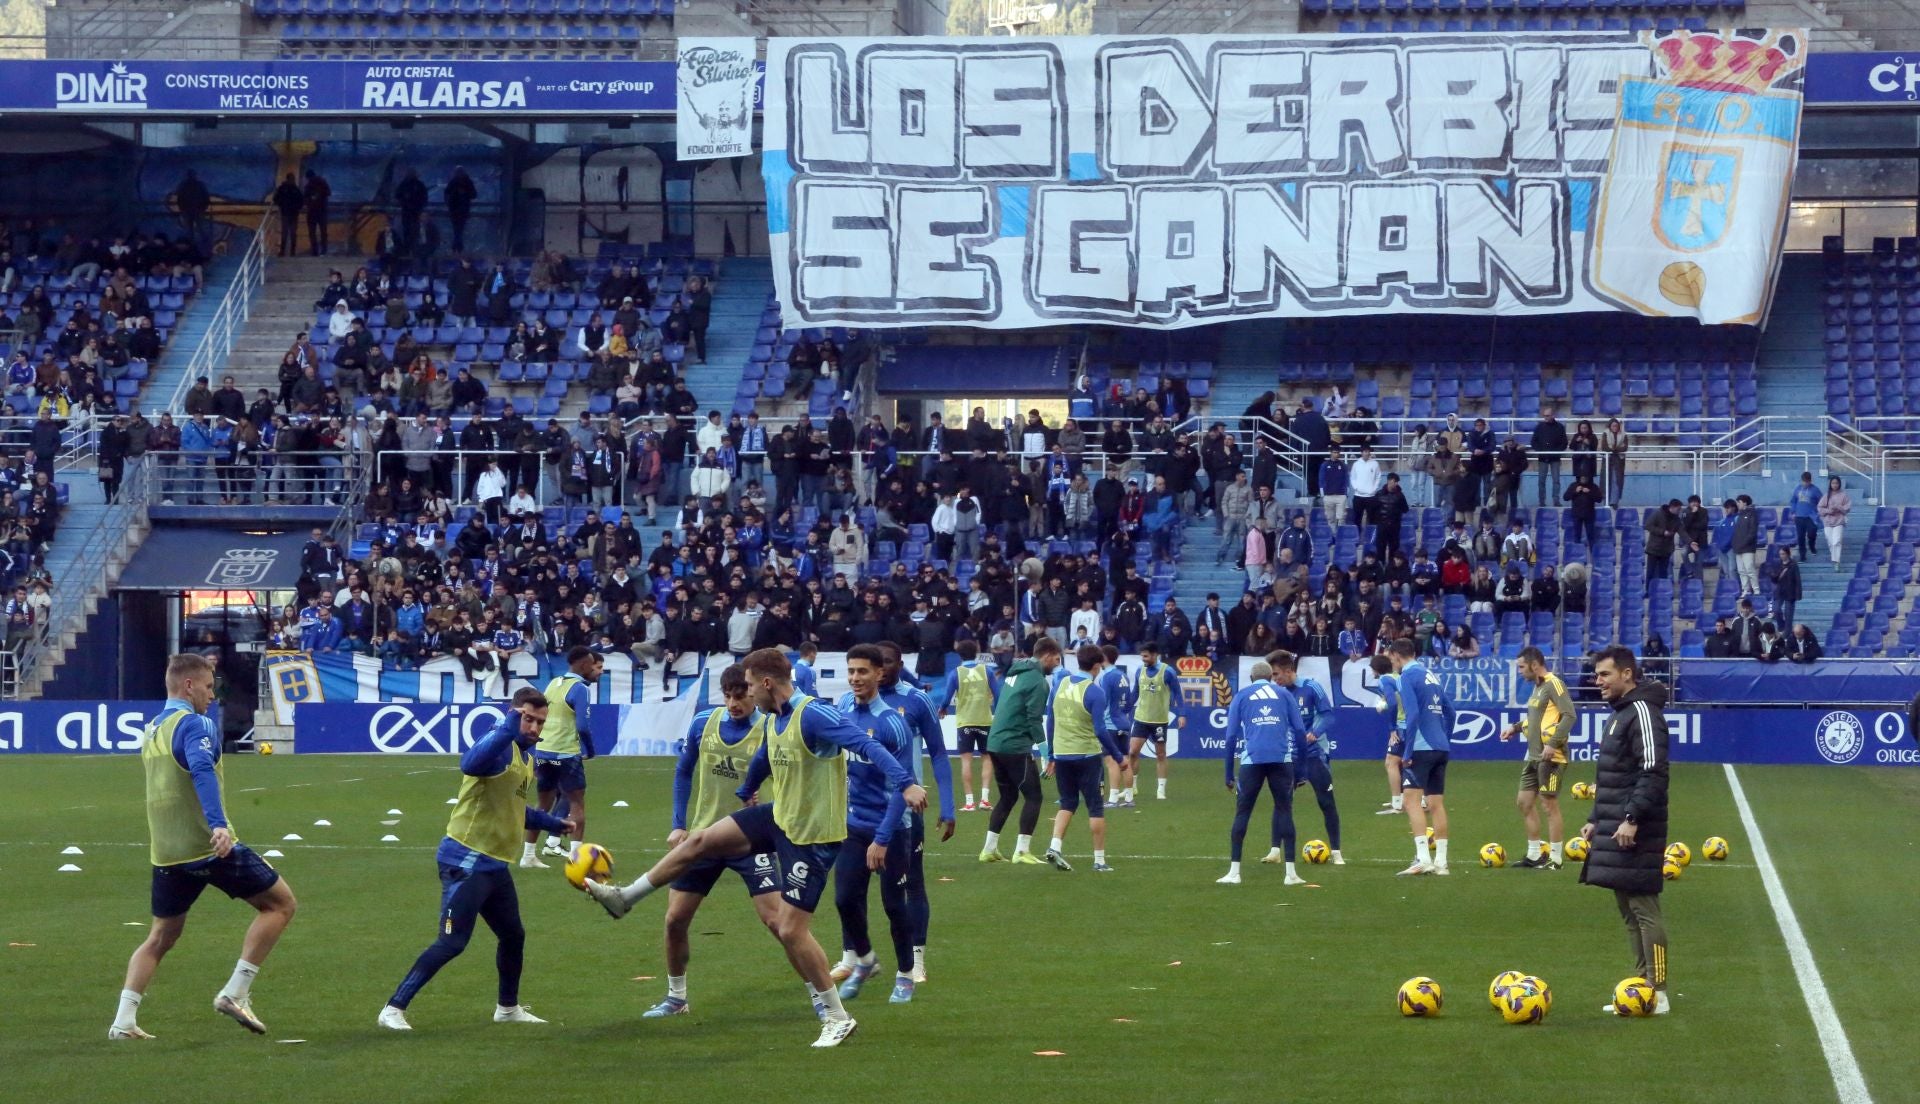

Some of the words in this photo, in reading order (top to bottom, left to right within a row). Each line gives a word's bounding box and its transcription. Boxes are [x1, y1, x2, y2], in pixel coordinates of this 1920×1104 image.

[366, 67, 400, 78] AUTO
[404, 67, 455, 78] CRISTAL
[165, 74, 309, 89] CONSTRUCCIONES
[569, 79, 605, 94] Cary
[607, 79, 654, 94] group
[220, 92, 309, 109] METÁLICAS
[362, 81, 527, 108] RALARSA
[788, 44, 1068, 179] LOS
[1097, 40, 1647, 179] DERBIS
[687, 145, 714, 155] FONDO
[716, 143, 742, 154] NORTE
[790, 179, 1000, 321] SE
[1024, 177, 1572, 322] GANAN
[1823, 713, 1858, 729] OVIEDO
[708, 742, 715, 751] 15
[712, 768, 739, 780] adidas
